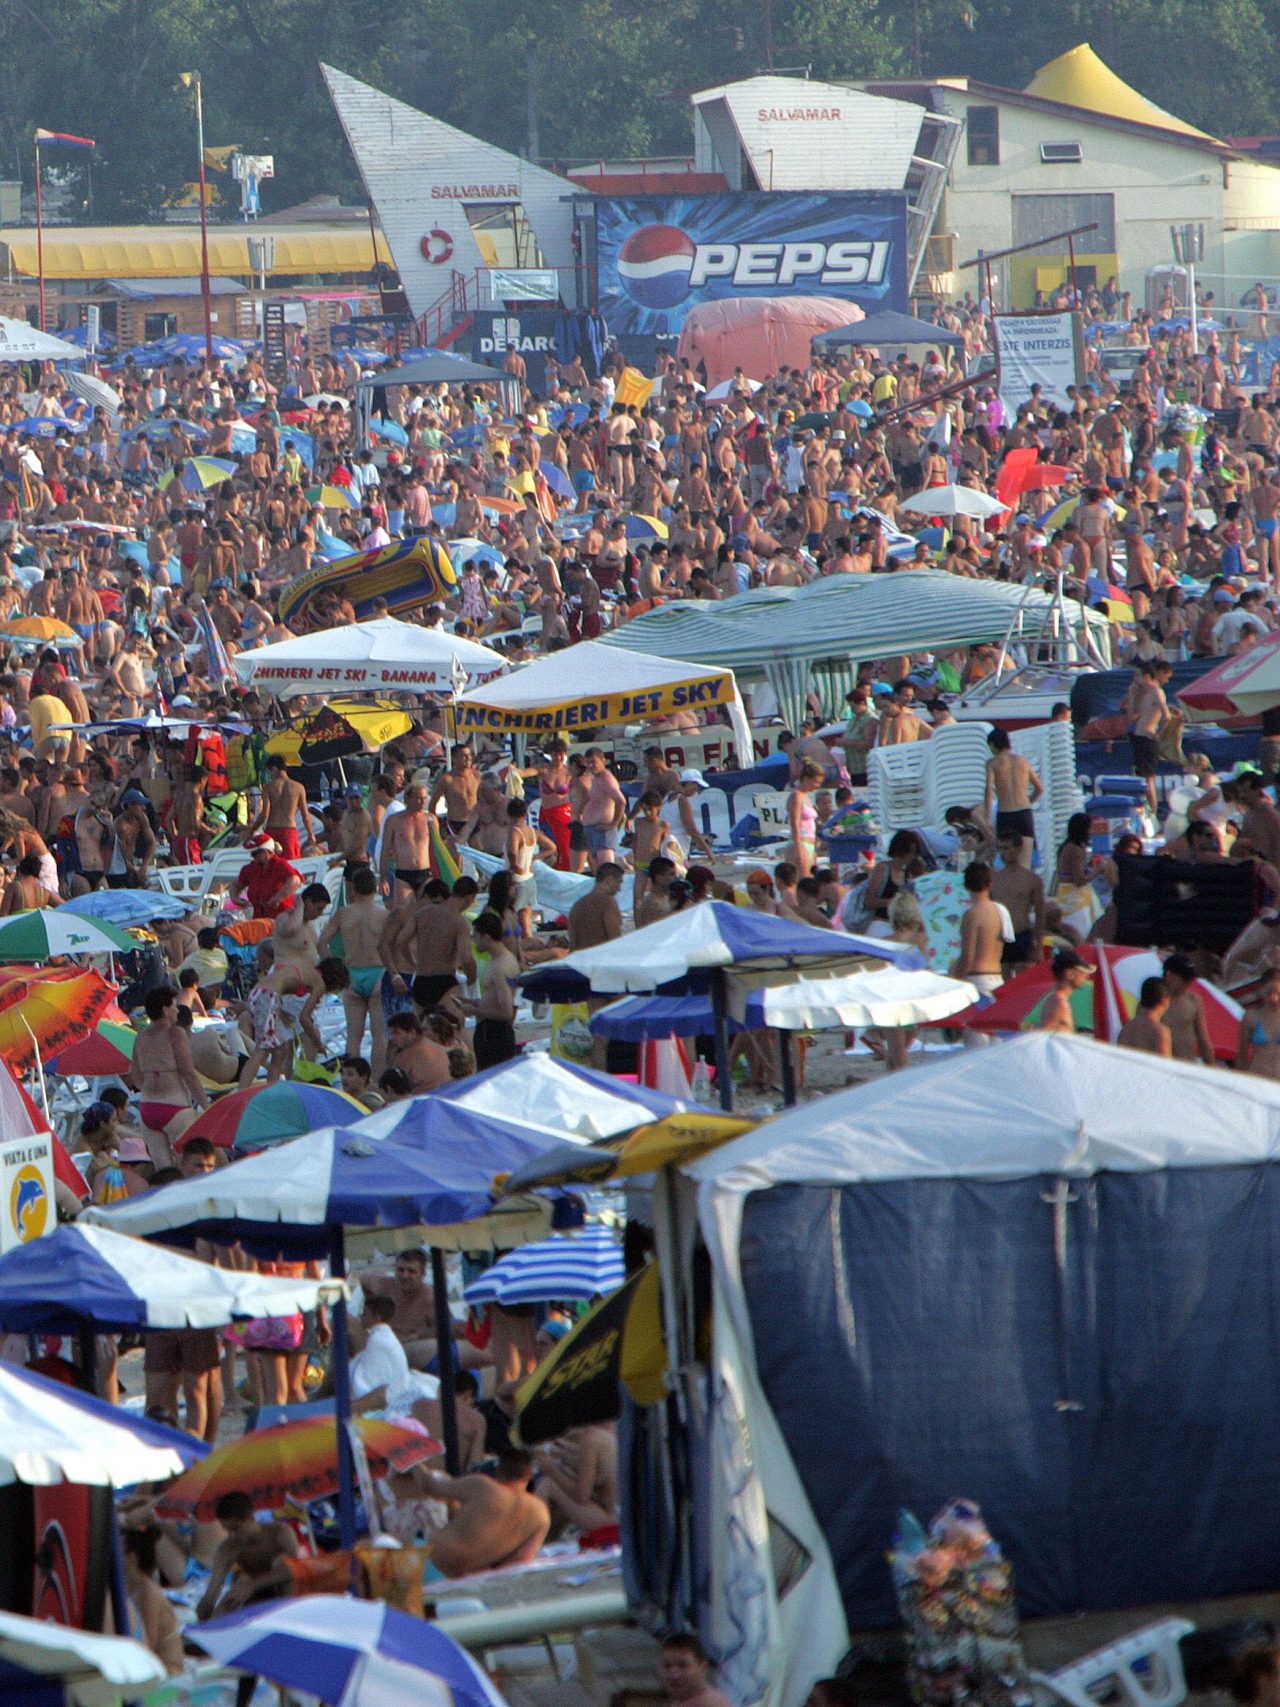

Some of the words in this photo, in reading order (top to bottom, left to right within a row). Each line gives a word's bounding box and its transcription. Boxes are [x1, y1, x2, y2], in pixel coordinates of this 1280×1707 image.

[757, 108, 842, 122] SALVAMAR
[431, 184, 520, 199] SALVAMAR
[688, 241, 891, 287] PEPSI
[1024, 338, 1072, 350] INTERZIS
[317, 668, 341, 680] JET
[344, 669, 367, 681] SKI
[381, 669, 437, 684] BANANA
[456, 700, 609, 729] ÎNCHIRIERI
[619, 691, 663, 717] JET
[671, 678, 724, 707] SKY
[3, 1151, 27, 1167] VIATA
[28, 1149, 33, 1161] E
